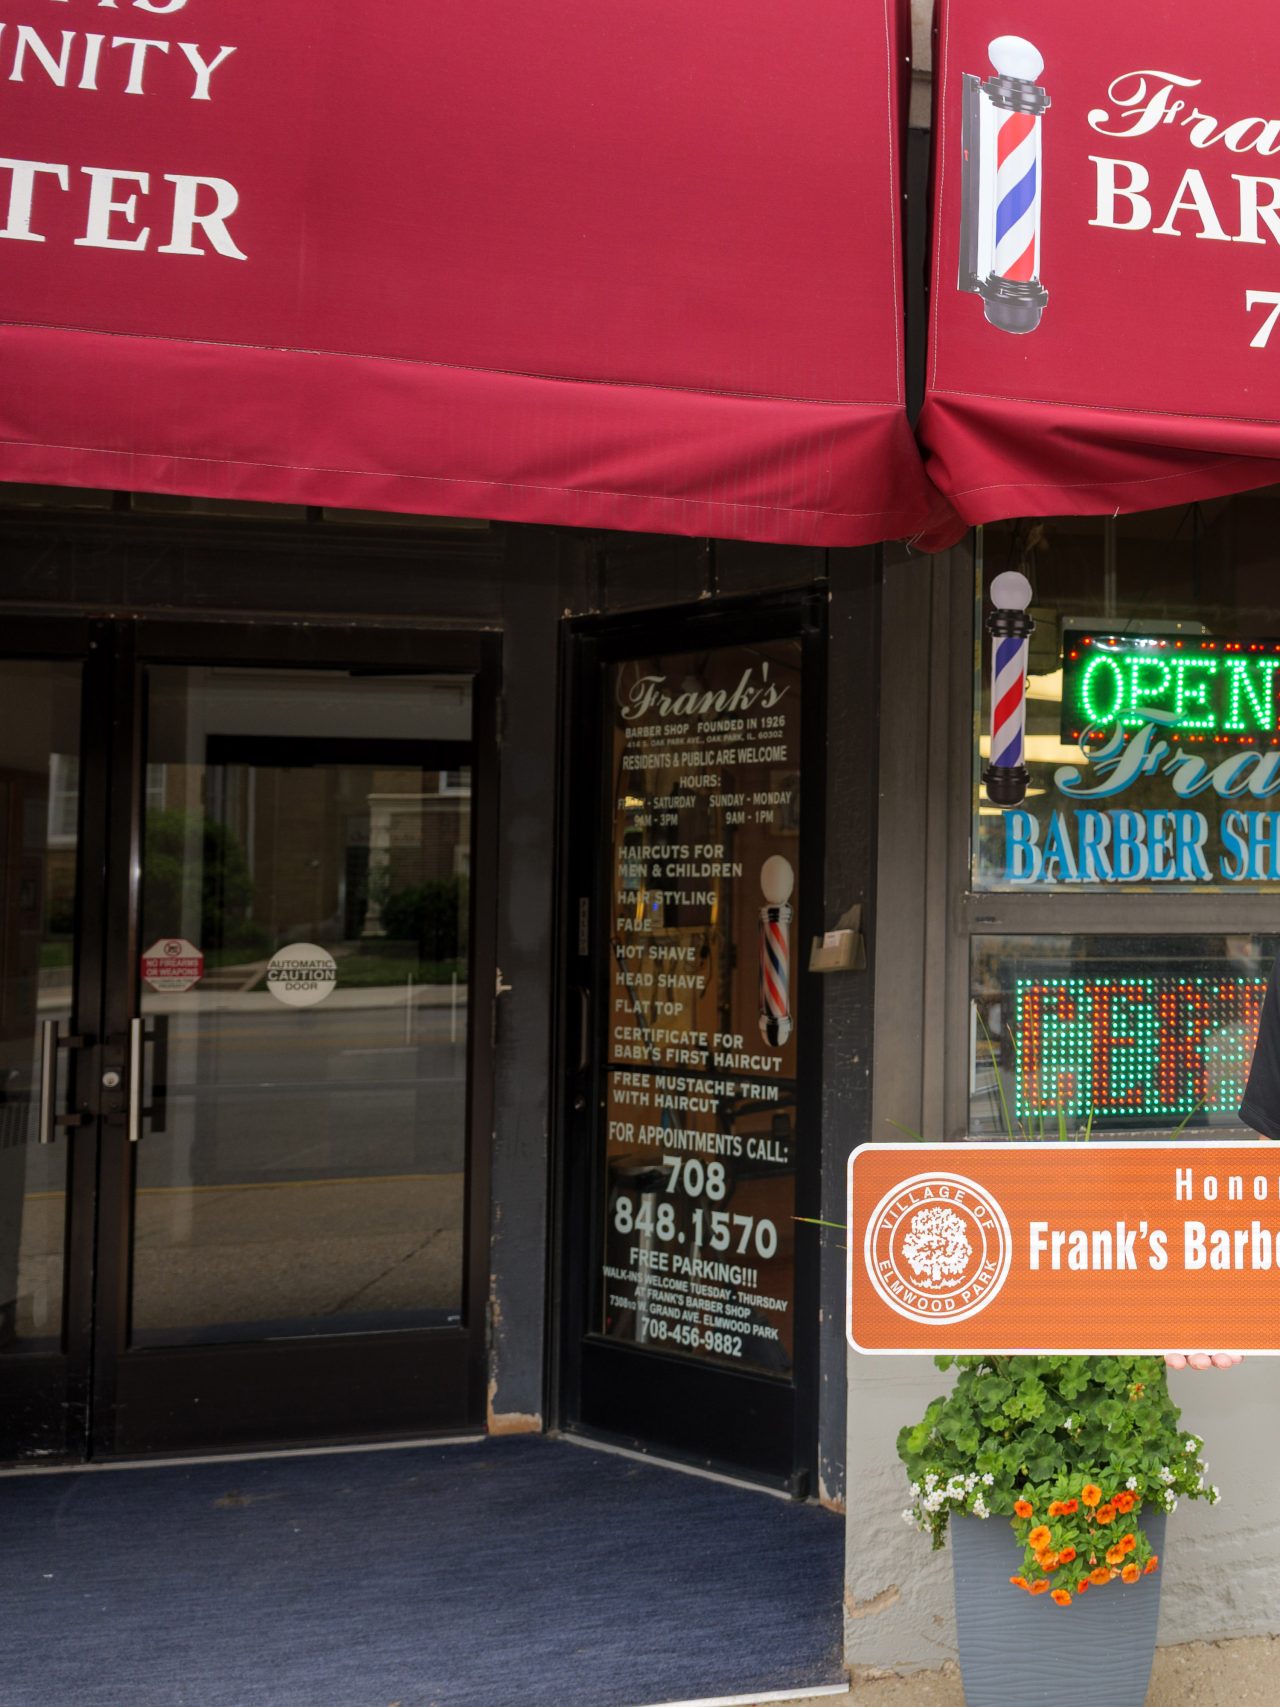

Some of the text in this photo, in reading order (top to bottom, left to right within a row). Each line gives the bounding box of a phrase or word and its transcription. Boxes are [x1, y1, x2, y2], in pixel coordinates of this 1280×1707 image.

[0, 23, 238, 101] NITY
[621, 662, 790, 720] Frank's
[1081, 655, 1280, 731] OPEN
[625, 715, 785, 739] BARBER SHOP FOUNDED IN 1926
[667, 737, 685, 746] PARK
[706, 735, 721, 743] OAK
[622, 745, 788, 770] RESIDENTS & PUBLIC ARE WELCOME
[679, 774, 721, 789] HOURS:
[653, 795, 696, 809] SATURDAY
[709, 793, 745, 807] SUNDAY
[753, 791, 792, 805] MONDAY
[660, 813, 678, 827] 3PM
[725, 811, 746, 825] 9AM
[755, 810, 774, 824] 1PM
[618, 844, 724, 859] HAIRCUTS FOR
[1003, 808, 1213, 885] BARBER
[618, 863, 743, 878] MEN & CHILDREN
[617, 891, 717, 905] HAIR STYLING
[616, 917, 652, 932] FADE
[271, 960, 333, 969] AUTOMATIC
[616, 945, 695, 961] HOT SHAVE
[268, 970, 336, 981] CAUTION
[285, 982, 318, 991] DOOR
[616, 973, 705, 990] HEAD SHAVE
[615, 999, 683, 1016] FLAT TOP
[614, 1026, 744, 1049] CERTIFICATE FOR
[614, 1044, 782, 1072] BABY'S FIRST HAIRCUT
[613, 1071, 779, 1101] FREE MUSTACHE TRIM
[613, 1089, 720, 1114] WITH HAIRCUT
[608, 1121, 788, 1163] FOR APPOINTMENTS CALL:
[663, 1154, 726, 1200] 708
[881, 1185, 995, 1230] VILLAGE OF
[614, 1196, 778, 1259] 848.1570
[1029, 1220, 1169, 1271] Frank's
[630, 1247, 758, 1288] FREE PARKING!!!
[602, 1266, 643, 1282] WALK-INS
[645, 1274, 688, 1292] WELCOME
[690, 1282, 731, 1300] TUESDAY
[737, 1291, 788, 1312] THURSDAY
[879, 1259, 998, 1312] ELMWOOD PARK
[634, 1286, 751, 1319] AT FRANK'S BARBER SHOP
[649, 1303, 681, 1319] GRAND
[703, 1314, 751, 1334] ELMWOOD
[752, 1324, 779, 1341] PARK
[641, 1316, 742, 1357] 708-456-9882
